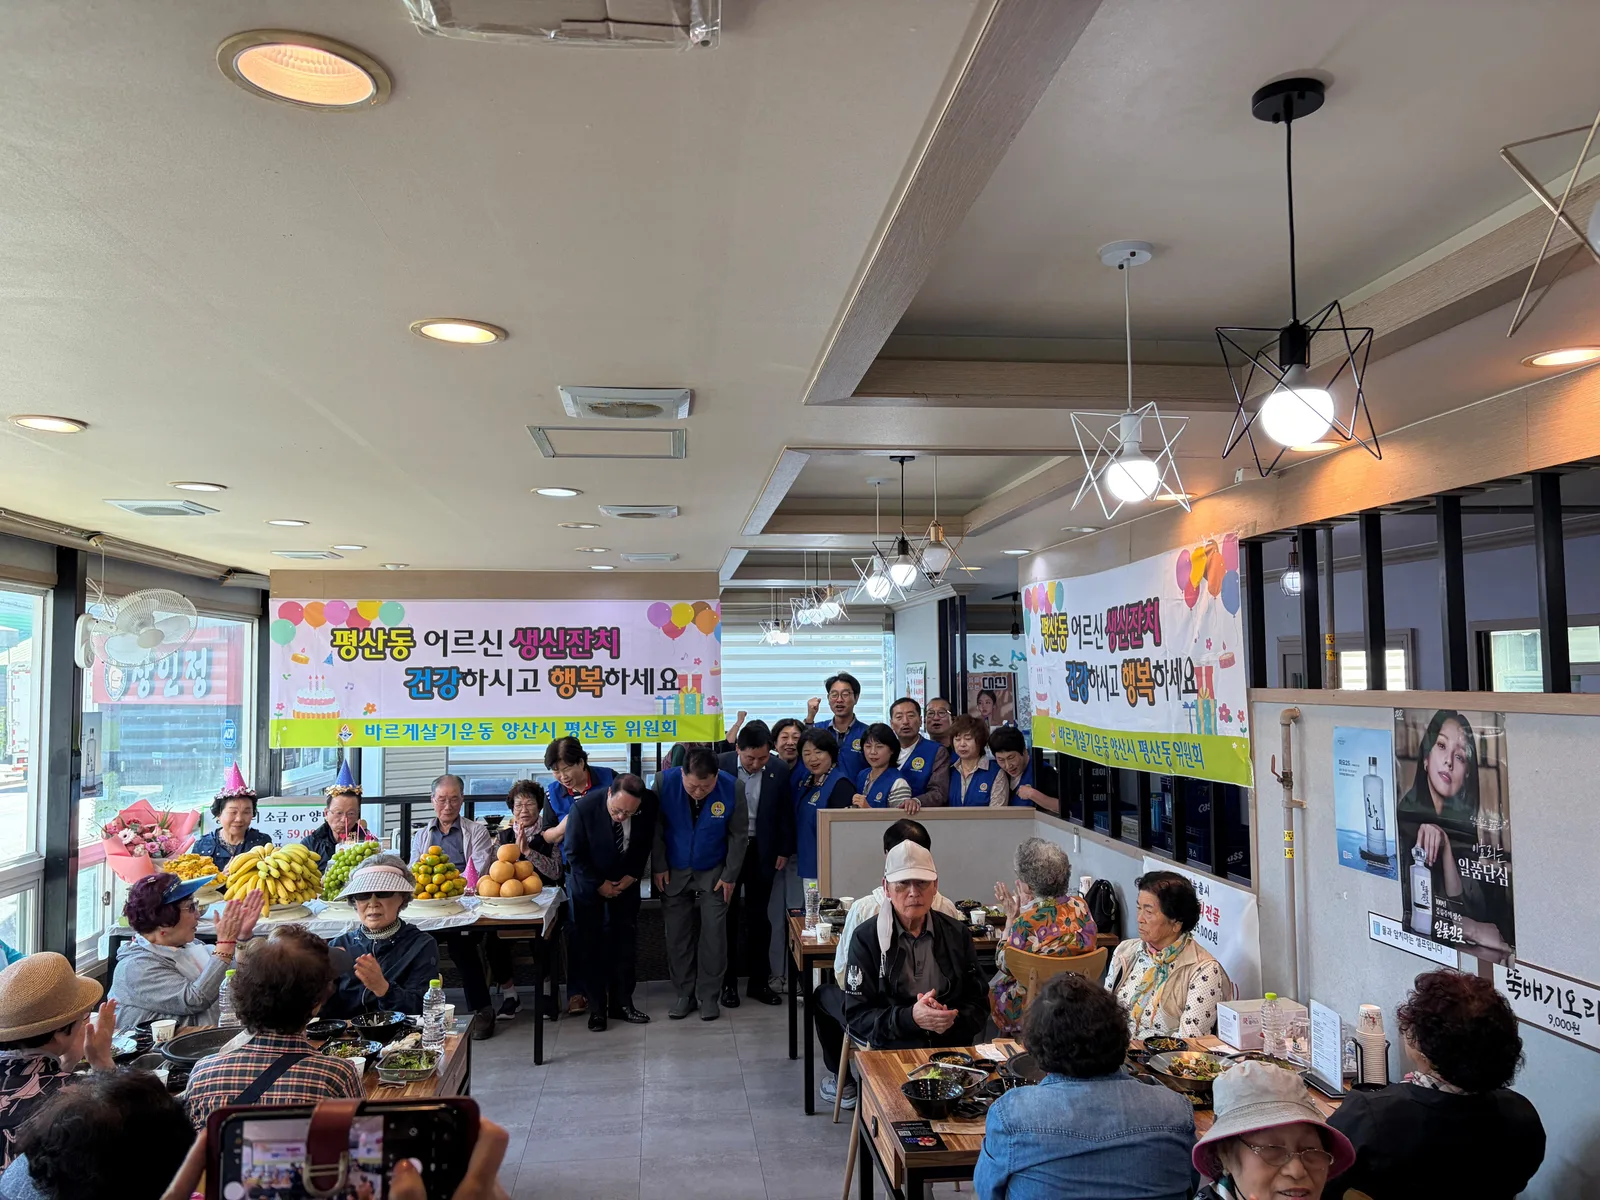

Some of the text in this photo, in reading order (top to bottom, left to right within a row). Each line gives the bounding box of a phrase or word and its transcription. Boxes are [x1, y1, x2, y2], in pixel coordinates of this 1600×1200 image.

[1040, 597, 1162, 653] 평산동 어르신 생신잔치
[331, 626, 620, 660] 평산동 어르신 생신잔치
[403, 666, 680, 700] 건강하시고 행복하세요
[1065, 657, 1198, 707] 건강하시고 행복하세요
[364, 719, 677, 741] 바르게살기운동 양산시 평산동 위원회
[1058, 726, 1205, 769] 바르게살기운동 양산시 평산동 위원회
[264, 811, 289, 824] 소금
[292, 814, 305, 822] or
[309, 810, 326, 823] 양
[1472, 839, 1508, 864] 이효리는
[1458, 858, 1509, 887] 일품단심
[1382, 925, 1443, 955] 물과 앞치마는 셀프입니다
[1434, 920, 1466, 944] 일품진로
[1506, 968, 1600, 1026] 뚝배기오리
[1538, 1013, 1581, 1036] 9,000원
